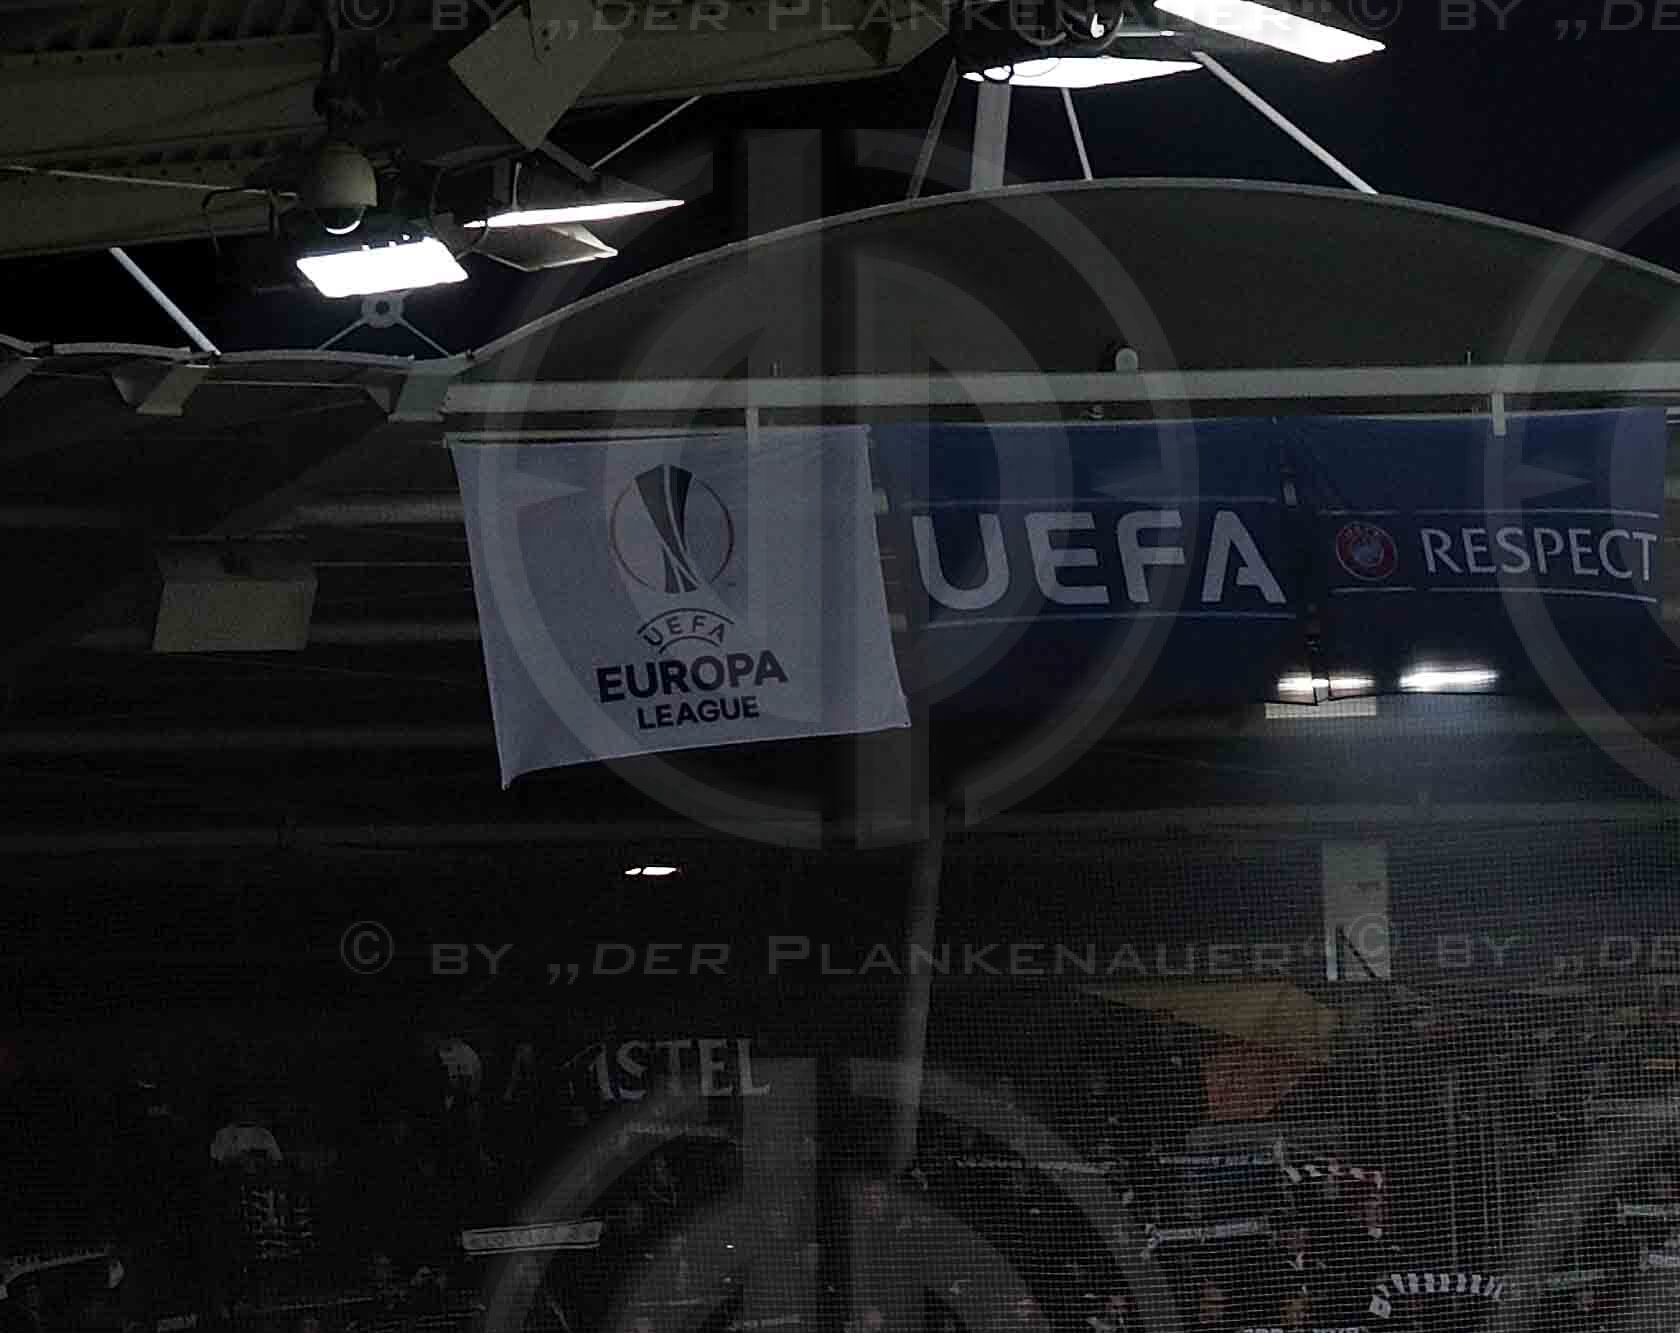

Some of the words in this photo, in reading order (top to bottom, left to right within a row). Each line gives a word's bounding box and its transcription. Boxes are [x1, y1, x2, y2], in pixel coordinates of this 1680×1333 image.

[917, 509, 1286, 609] UEFA
[1420, 529, 1658, 582] RESPECT
[641, 614, 731, 650] UEFA
[598, 651, 787, 703] EUROPA
[637, 697, 760, 730] LEAGUE
